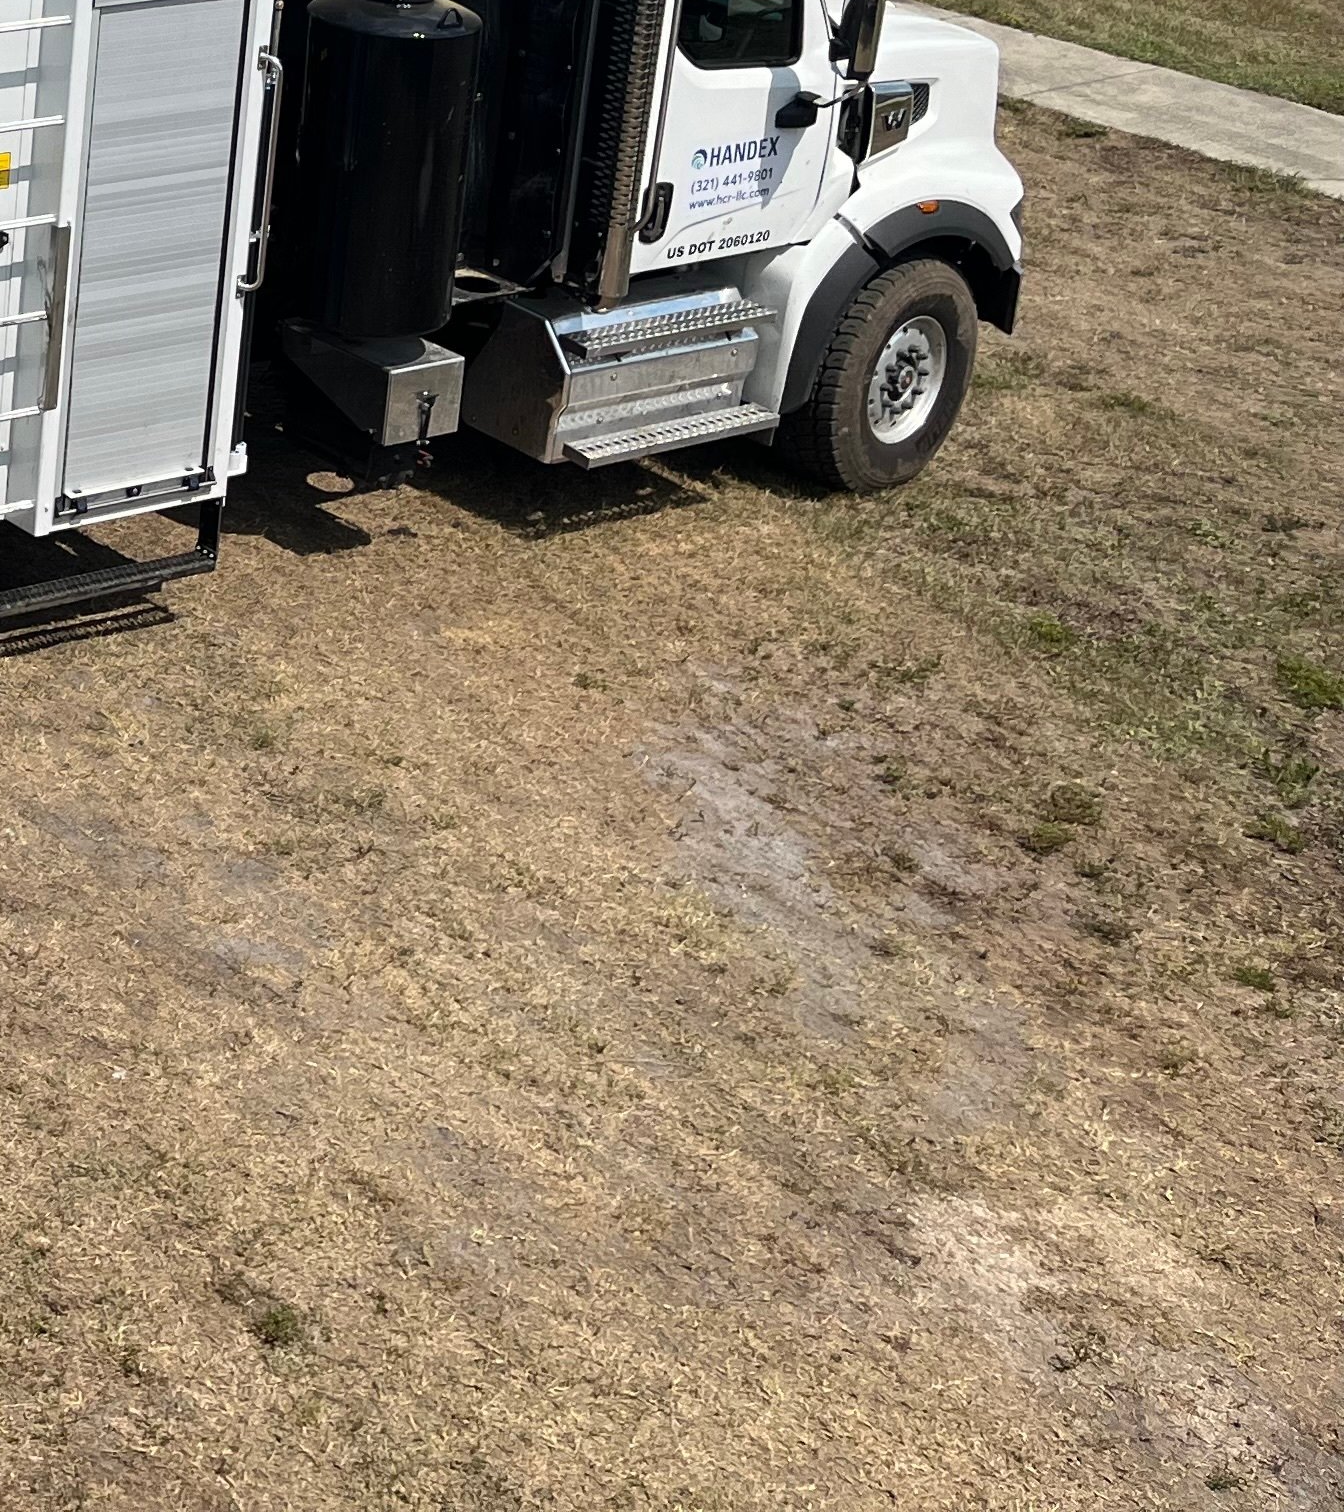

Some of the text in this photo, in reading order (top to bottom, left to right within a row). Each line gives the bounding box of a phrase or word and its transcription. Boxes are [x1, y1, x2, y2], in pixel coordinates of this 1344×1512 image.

[709, 135, 780, 168] HANDEX
[691, 167, 773, 195] (321) 441-9801
[689, 187, 770, 210] www.hcr-llc.com
[666, 229, 771, 259] US DOT 2060120
